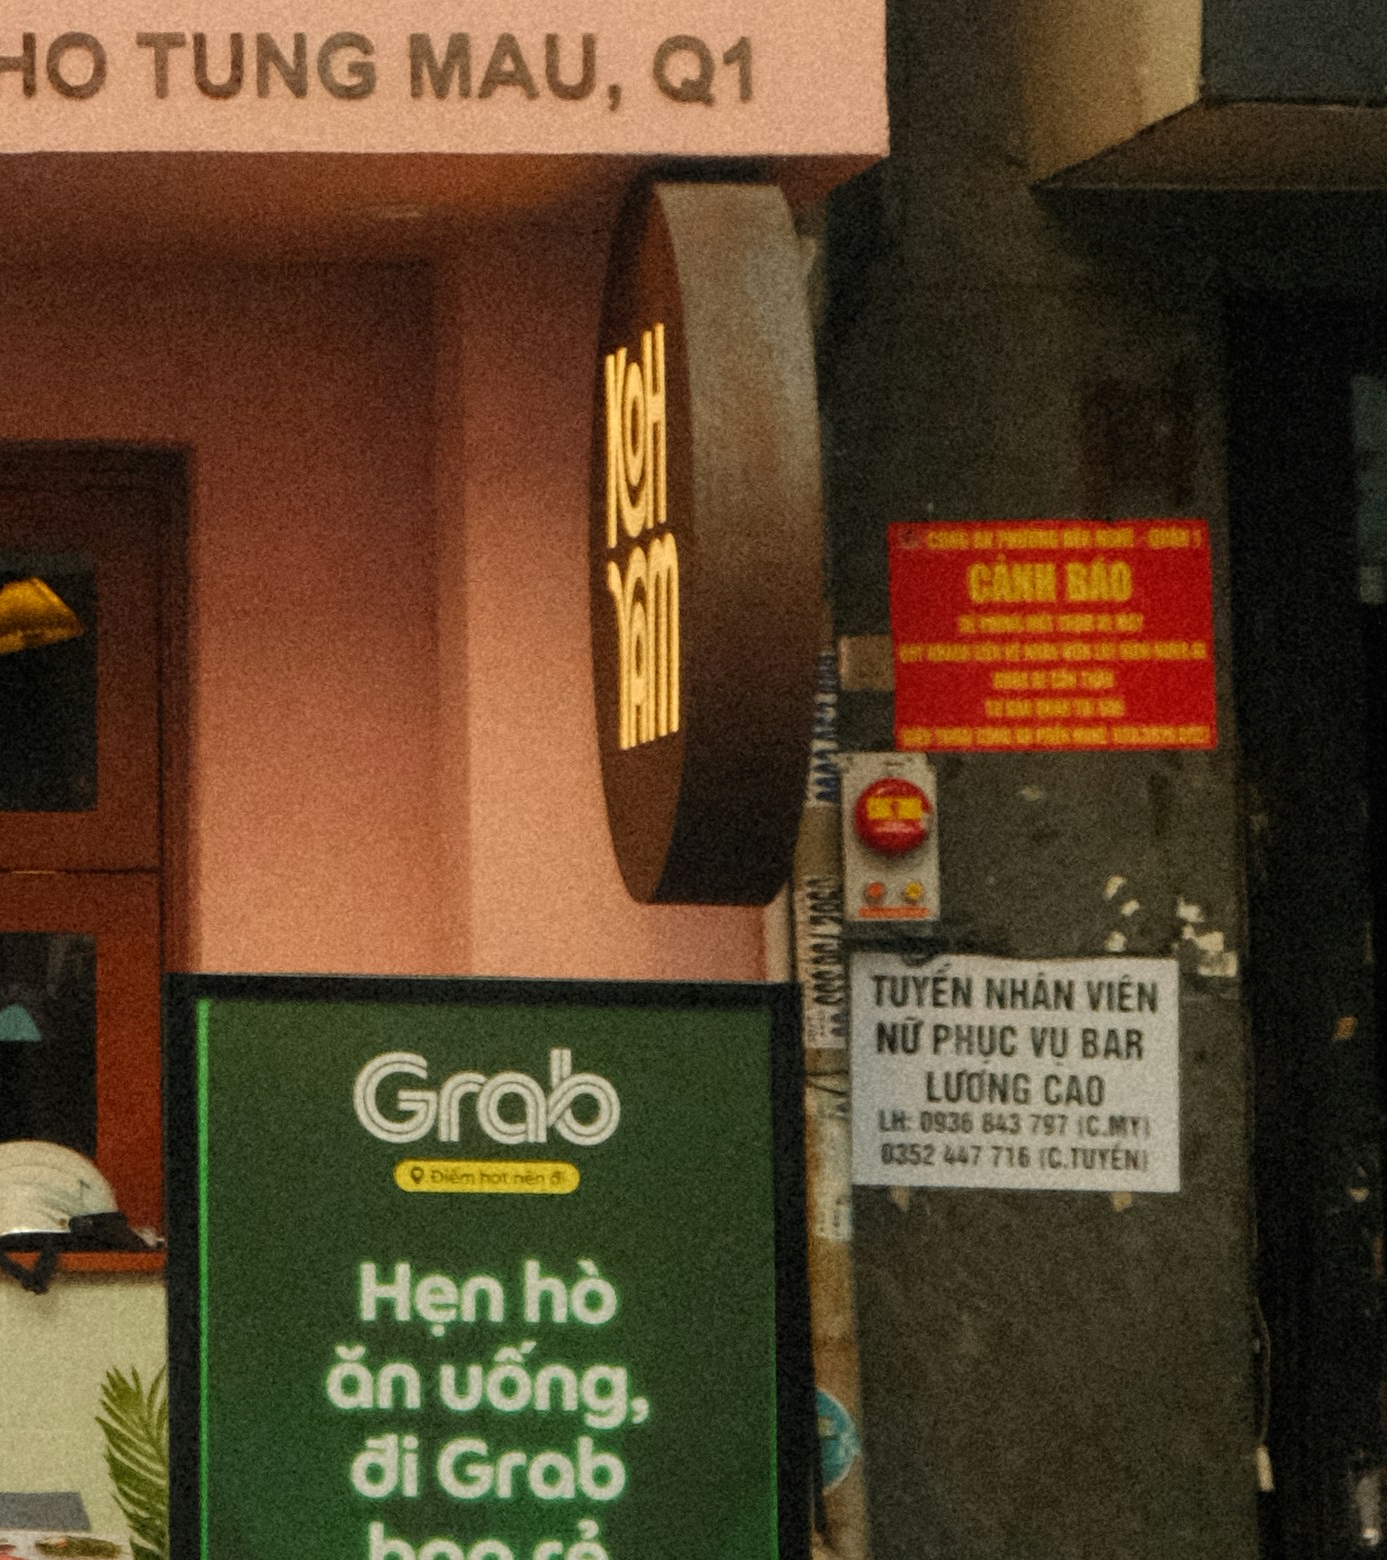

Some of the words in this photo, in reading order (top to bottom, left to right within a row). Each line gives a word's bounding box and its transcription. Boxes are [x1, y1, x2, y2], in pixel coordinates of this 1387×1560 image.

[136, 30, 378, 101] TUNG
[408, 32, 623, 112] MAU,
[650, 34, 756, 108] Q1
[985, 972, 1075, 1012] NHÂN
[1085, 972, 1159, 1013] VIÊN
[932, 1024, 1019, 1064] PHỤC
[1030, 1026, 1070, 1067] VỤ
[1081, 1027, 1145, 1060] BAR
[353, 1048, 621, 1146] Grab
[1043, 1073, 1106, 1108] CAO
[943, 1144, 982, 1167] 447
[359, 1261, 505, 1337] Hẹn
[525, 1259, 618, 1325] hò
[327, 1345, 421, 1410] ăn
[439, 1340, 650, 1429] uống,
[350, 1435, 419, 1499] đi
[436, 1436, 627, 1501] Grab
